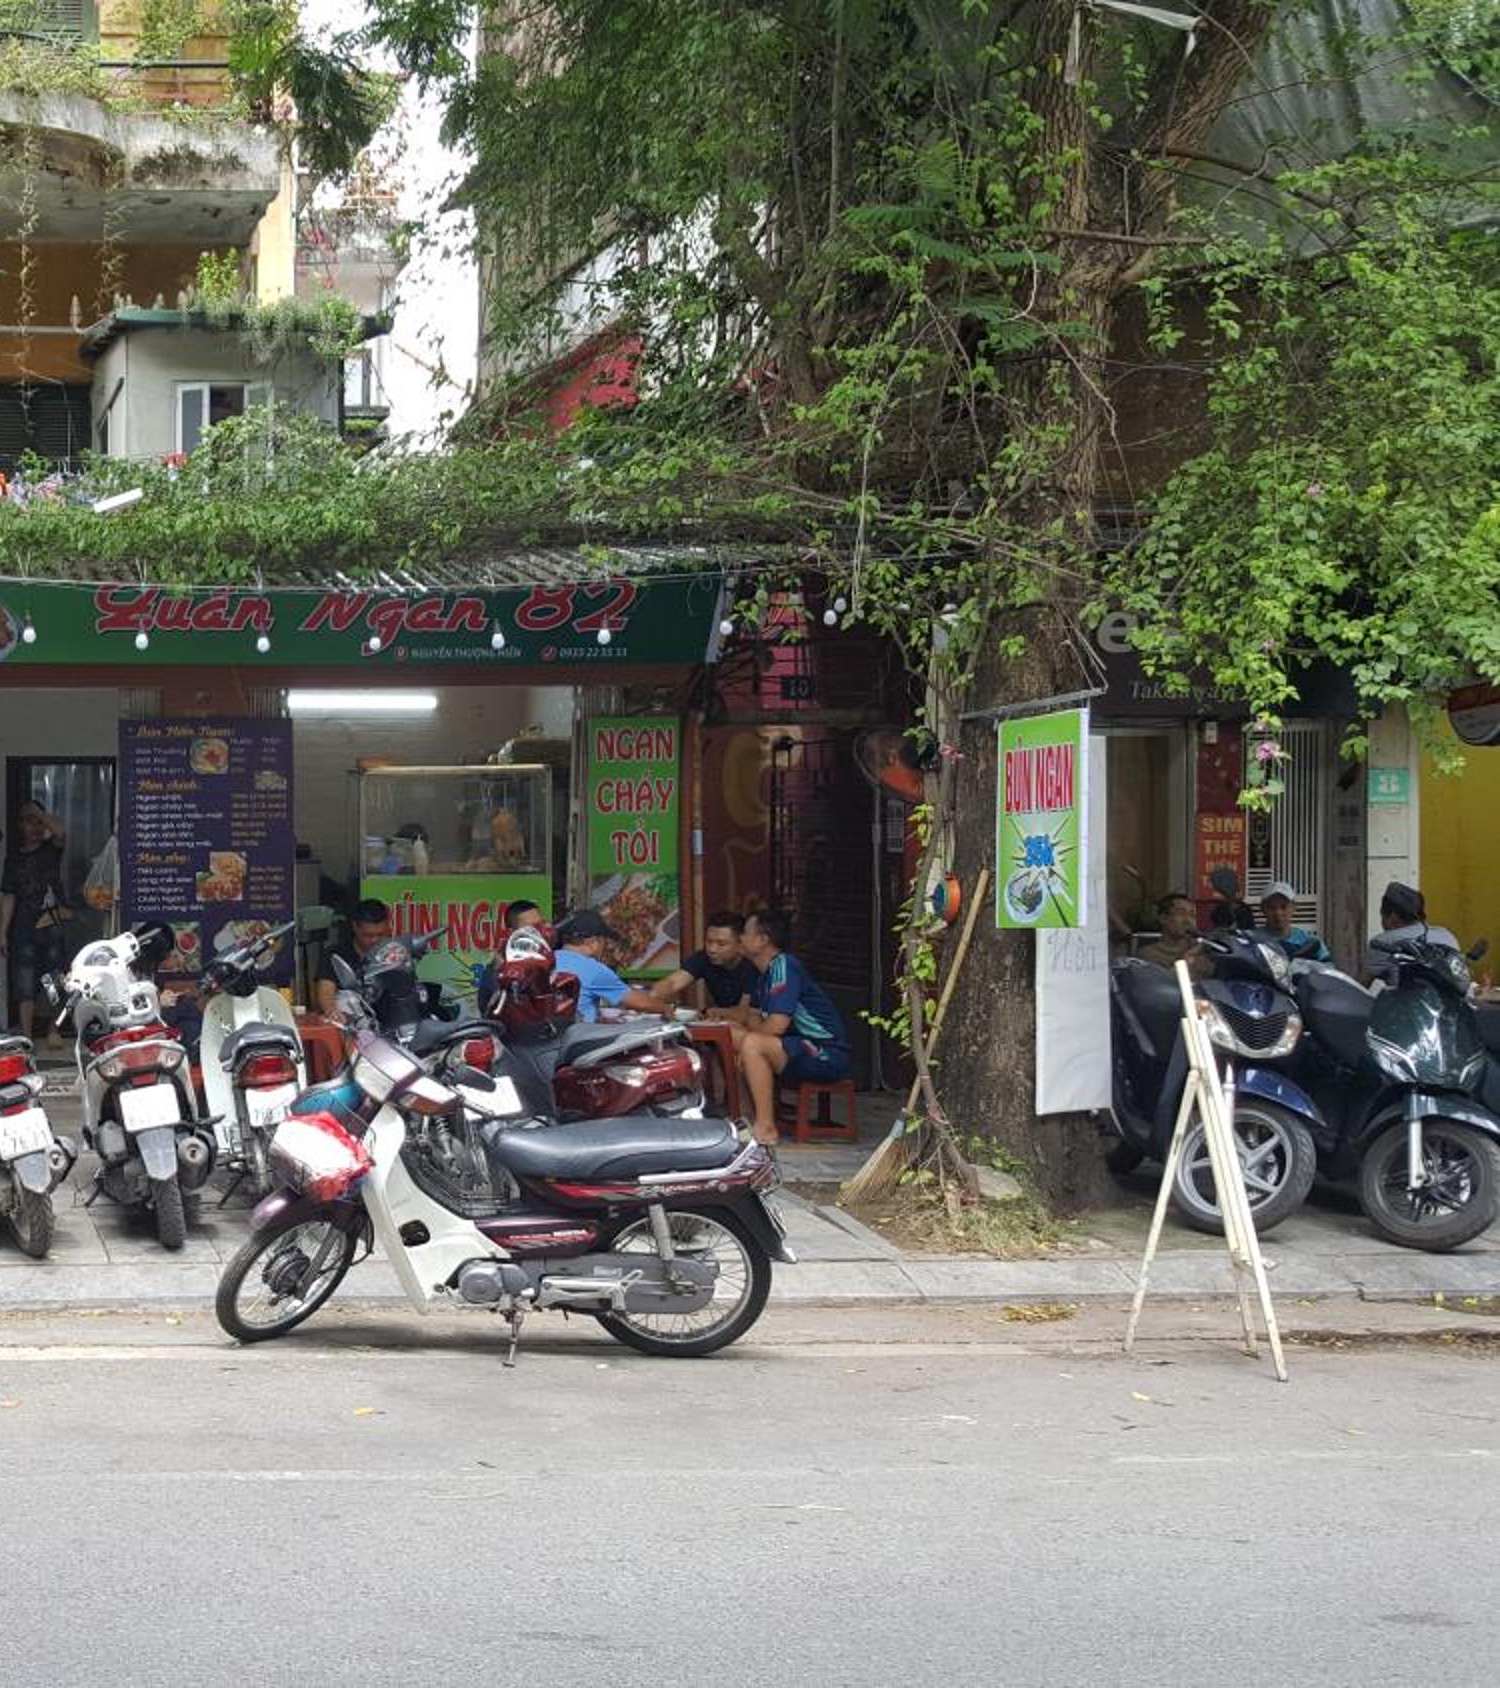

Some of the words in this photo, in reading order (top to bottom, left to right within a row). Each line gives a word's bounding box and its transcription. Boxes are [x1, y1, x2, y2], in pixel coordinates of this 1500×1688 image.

[301, 590, 487, 656] Ngan
[515, 575, 638, 632] 82
[596, 727, 676, 762] NGAN
[596, 768, 675, 813] CHÁY
[1036, 744, 1074, 811] NGAN
[610, 818, 660, 864] TỎI
[1202, 817, 1243, 832] SIM
